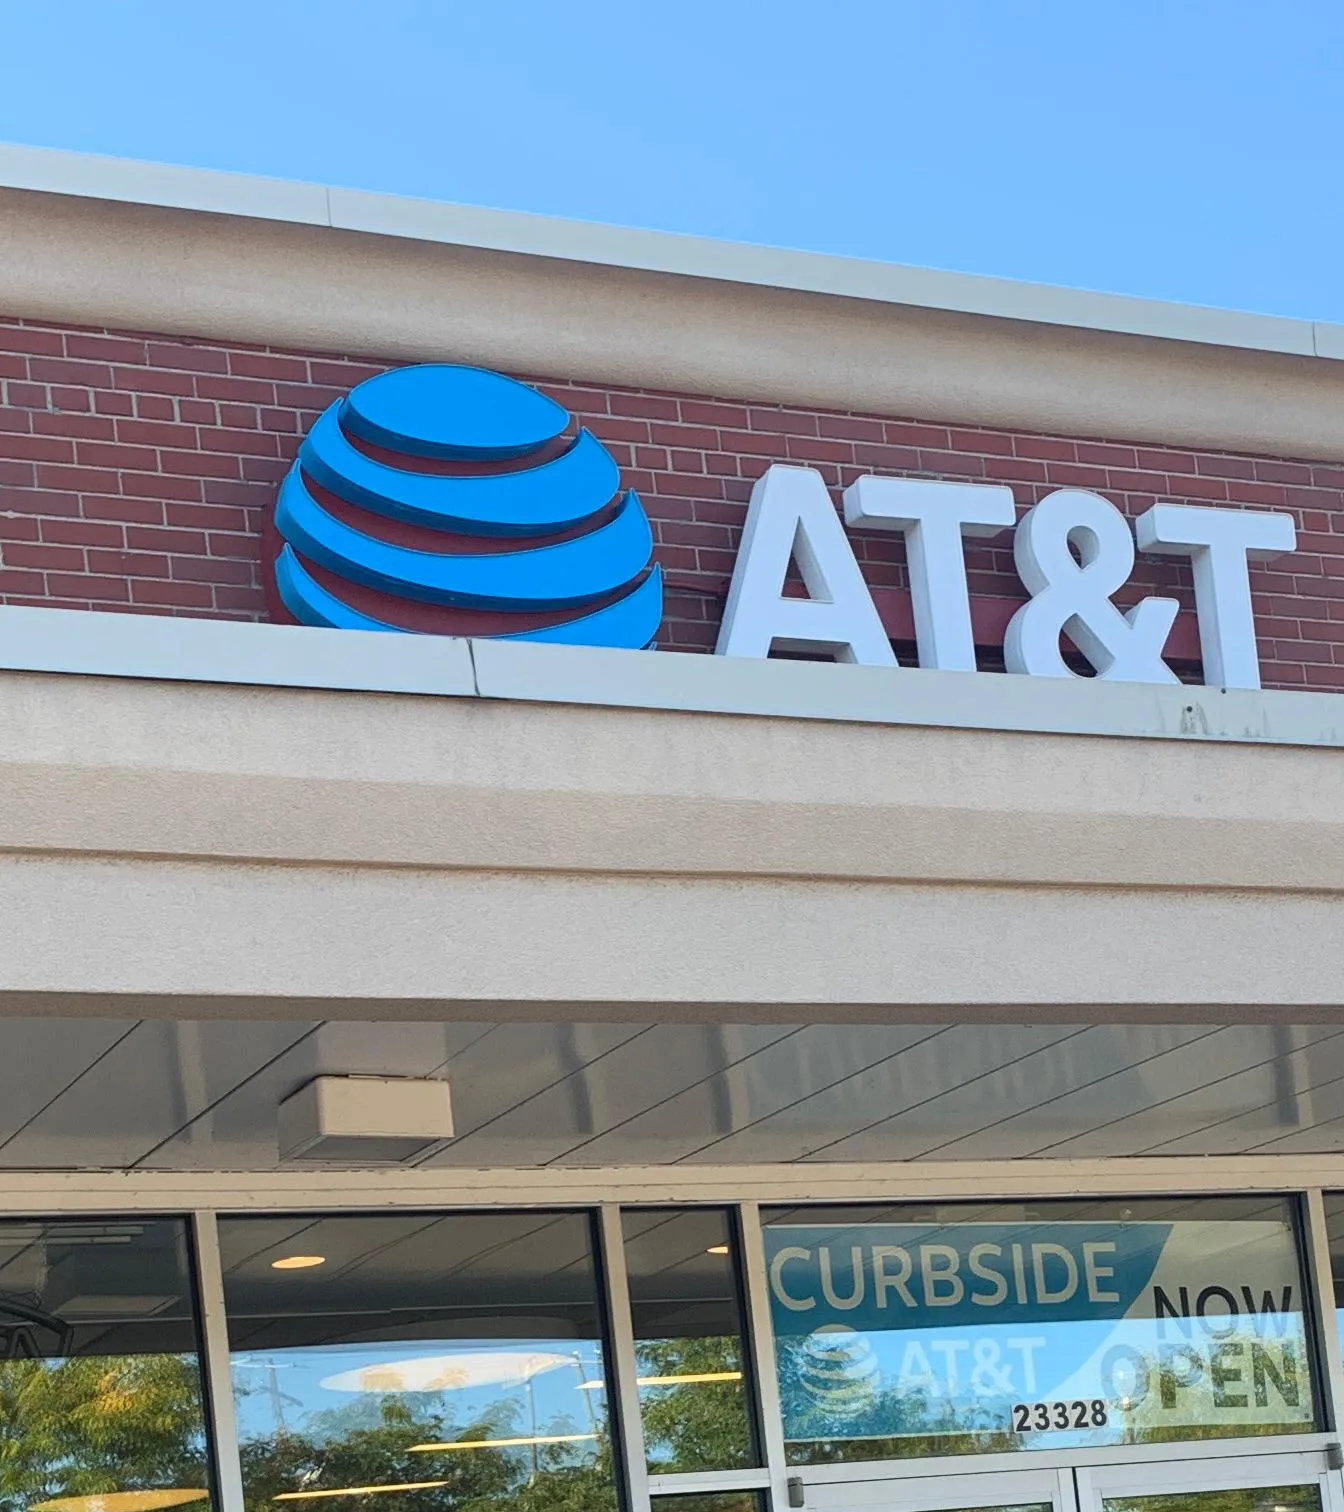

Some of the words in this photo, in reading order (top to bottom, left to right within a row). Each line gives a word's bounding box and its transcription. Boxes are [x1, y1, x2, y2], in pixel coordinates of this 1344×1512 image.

[715, 463, 1297, 689] AT&T
[770, 1241, 1120, 1311] CURBSIDE
[1153, 1284, 1293, 1340] NOW
[898, 1336, 1046, 1398] AT&T
[1100, 1340, 1301, 1411] OPEN
[1013, 1400, 1108, 1433] 23328
